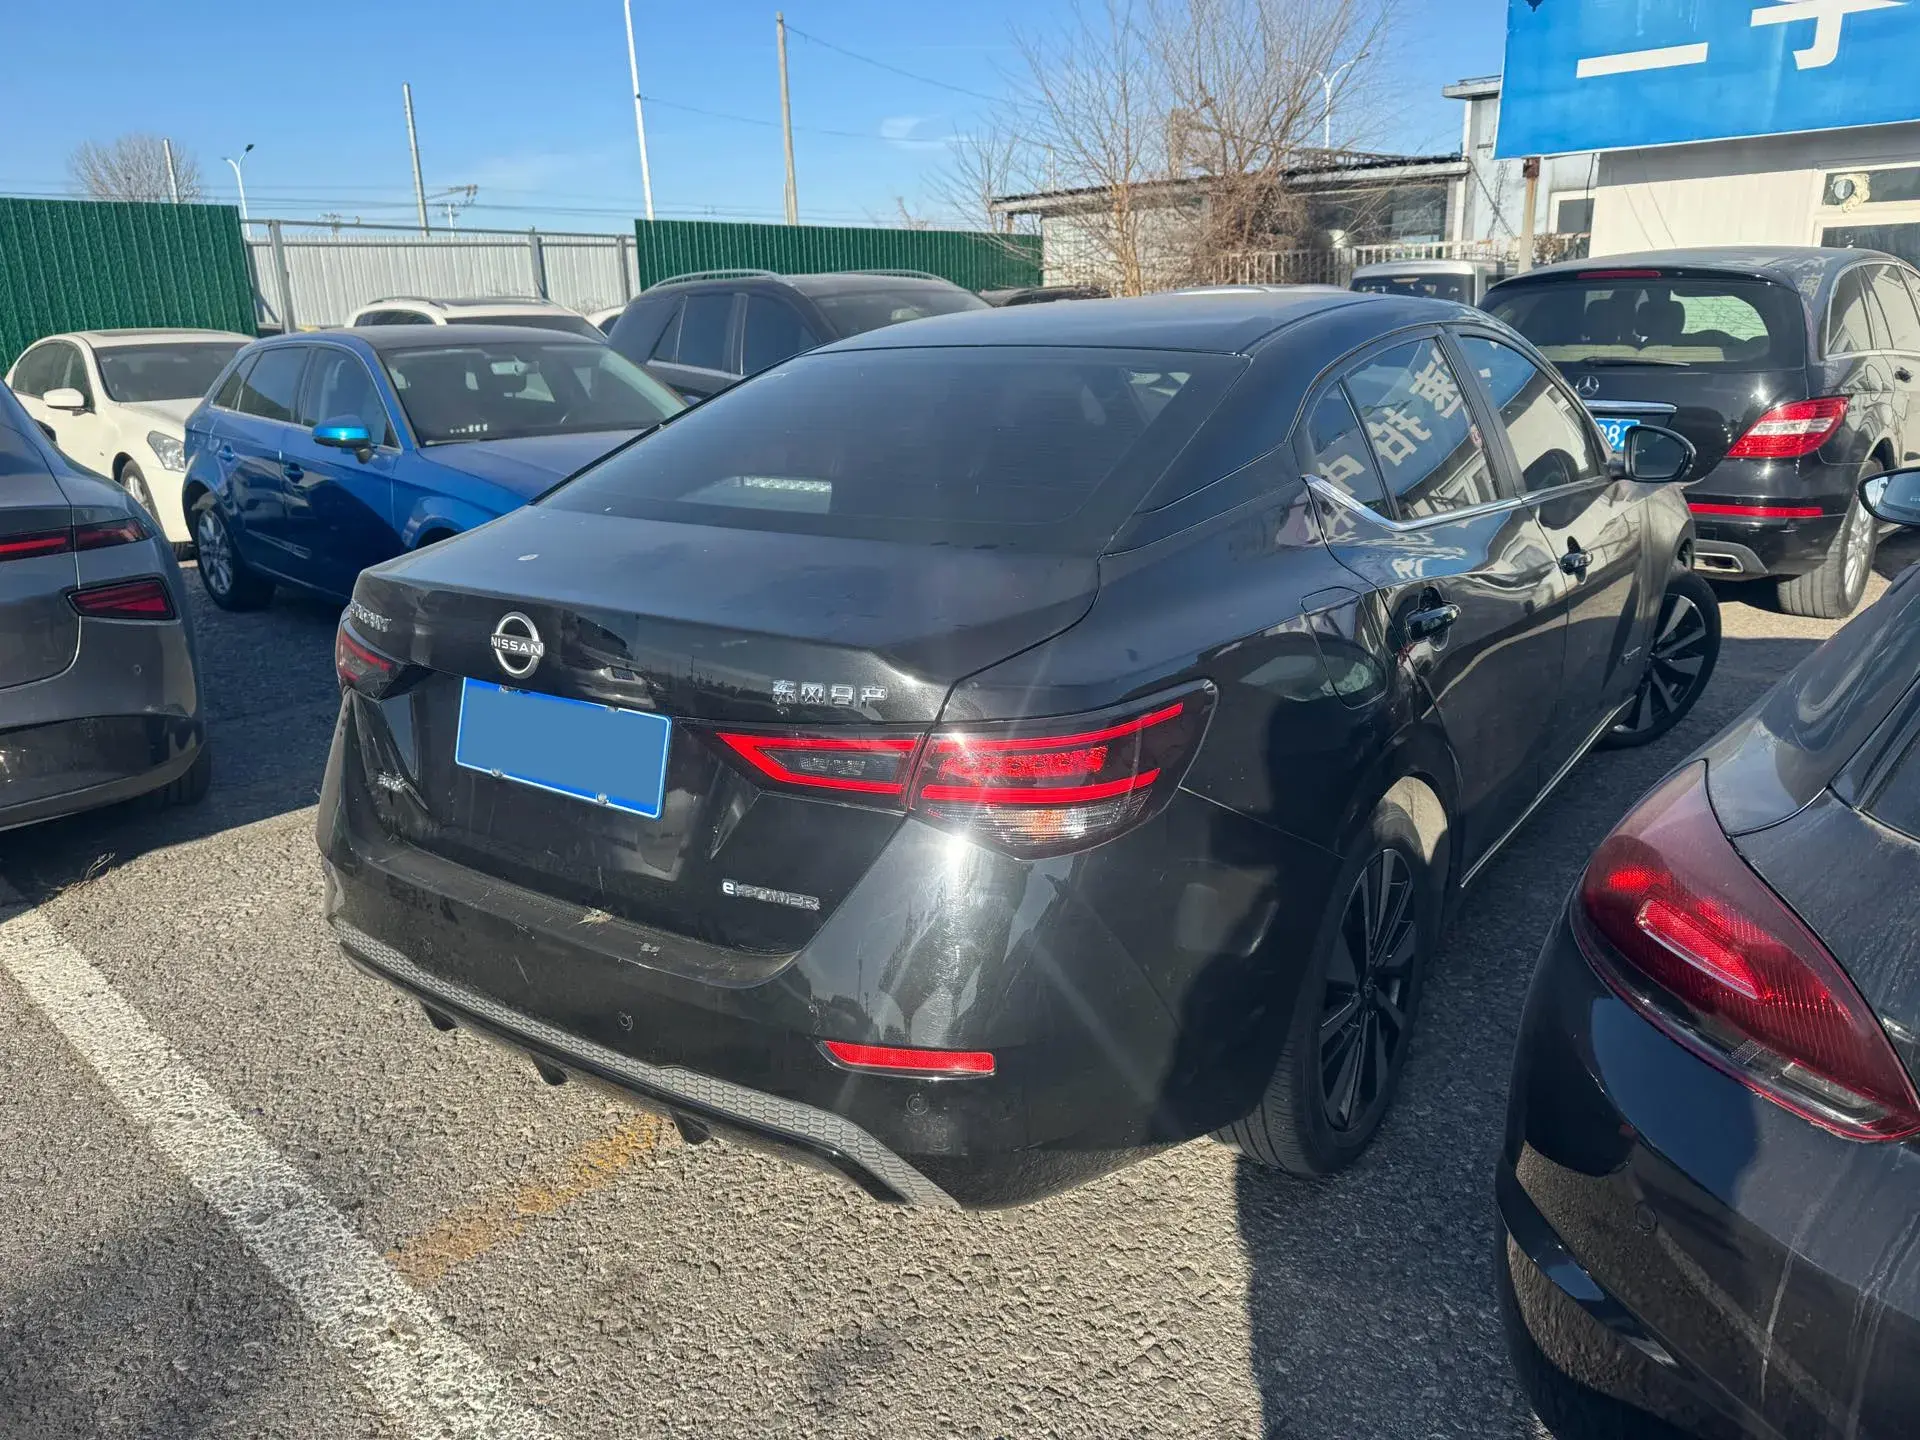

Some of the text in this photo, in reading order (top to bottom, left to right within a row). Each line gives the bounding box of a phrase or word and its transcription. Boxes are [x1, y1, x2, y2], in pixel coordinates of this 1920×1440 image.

[491, 636, 541, 654] NISSAN
[773, 679, 887, 707] 东风日产
